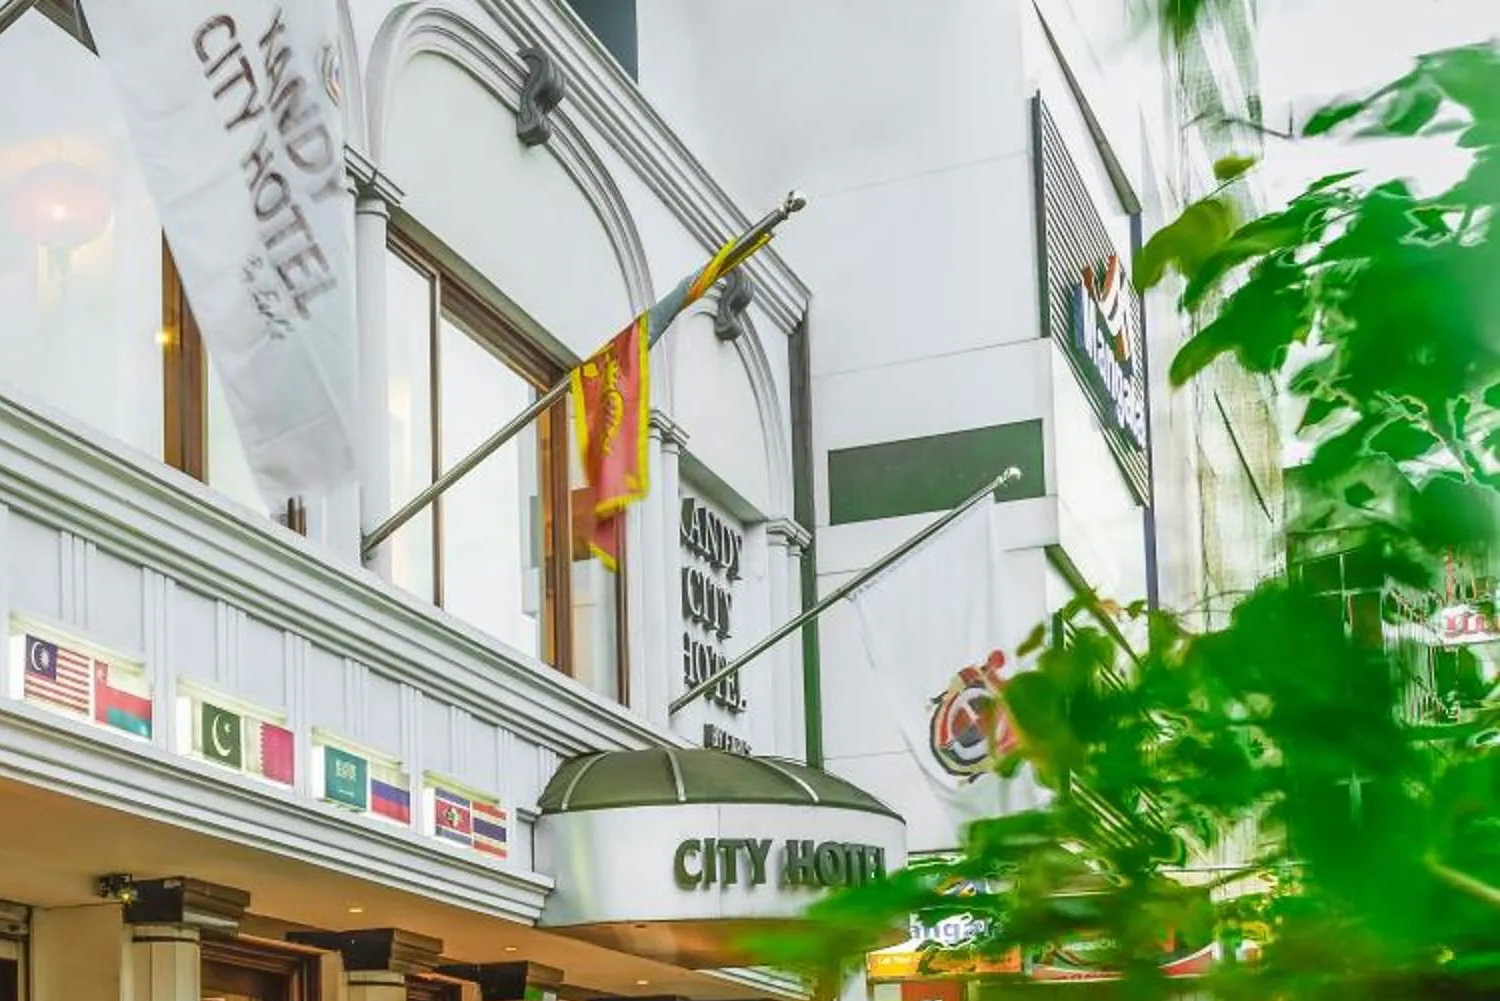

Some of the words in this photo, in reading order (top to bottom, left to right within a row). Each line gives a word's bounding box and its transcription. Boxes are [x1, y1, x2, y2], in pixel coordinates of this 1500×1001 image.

[191, 13, 264, 131] CITY
[241, 132, 337, 320] HOTEL
[673, 837, 773, 890] CITY
